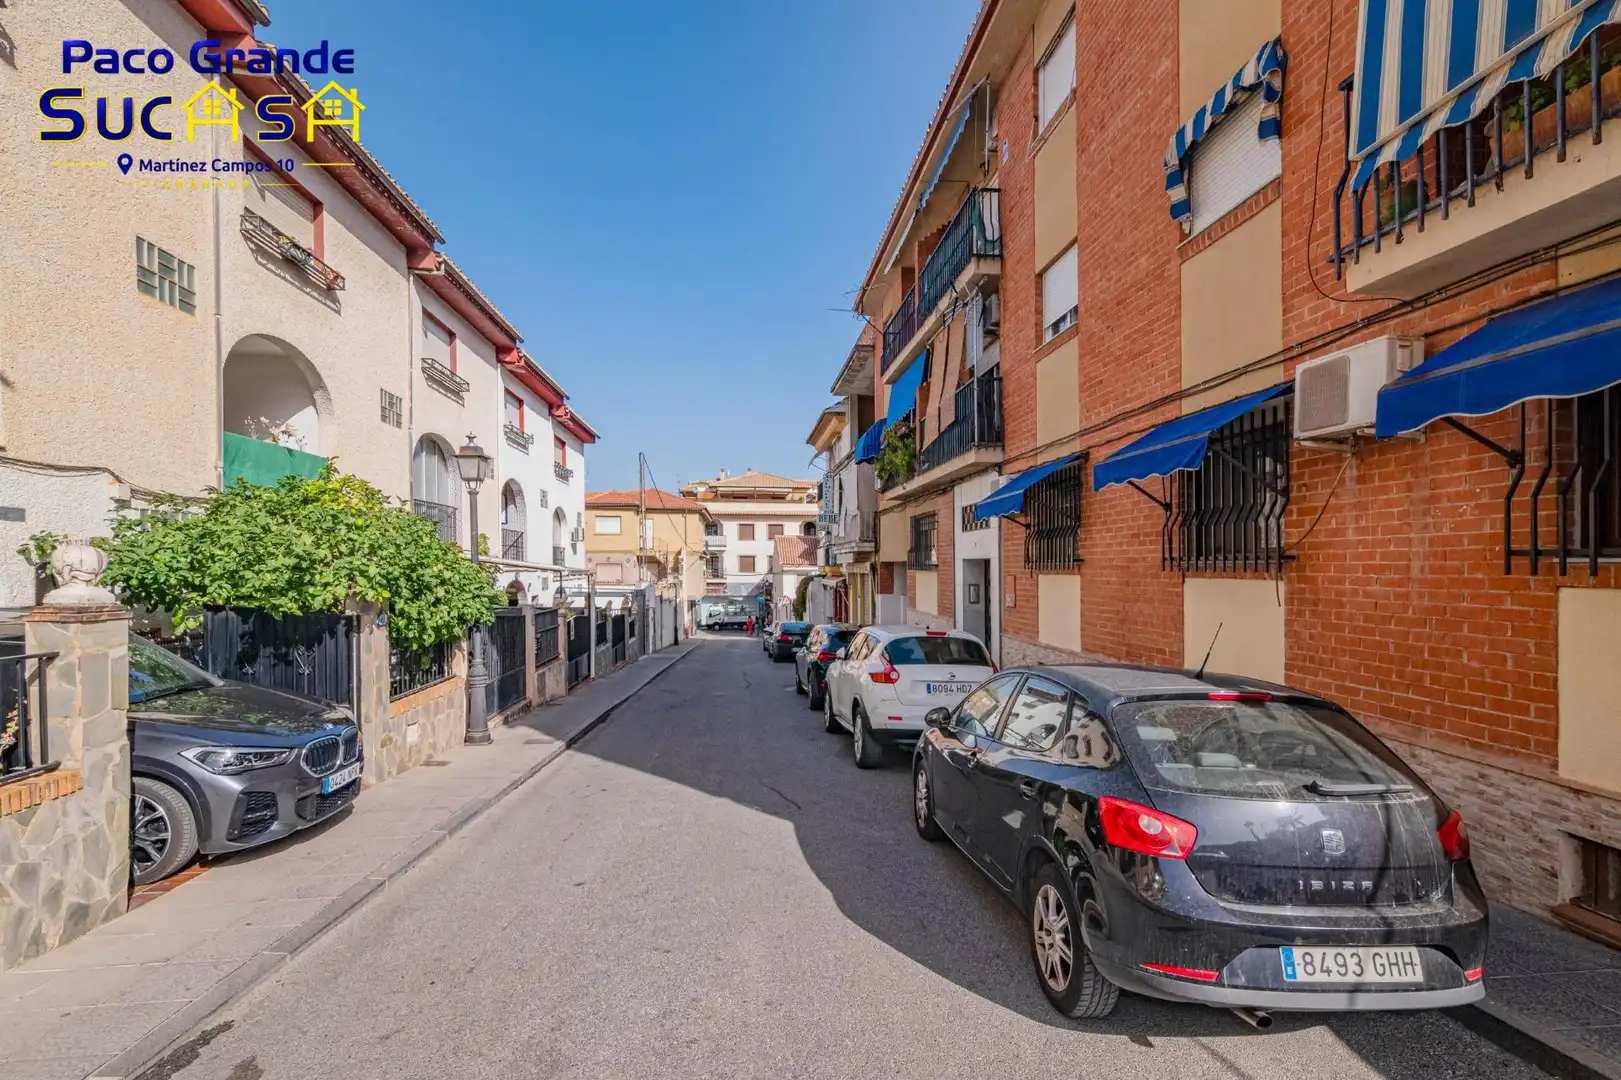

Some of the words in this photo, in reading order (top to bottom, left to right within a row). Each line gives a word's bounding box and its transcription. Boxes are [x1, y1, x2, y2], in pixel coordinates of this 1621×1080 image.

[932, 684, 954, 693] 8094
[1298, 880, 1373, 891] IBIZA
[1302, 951, 1364, 977] 8493
[1372, 951, 1417, 977] GHH
